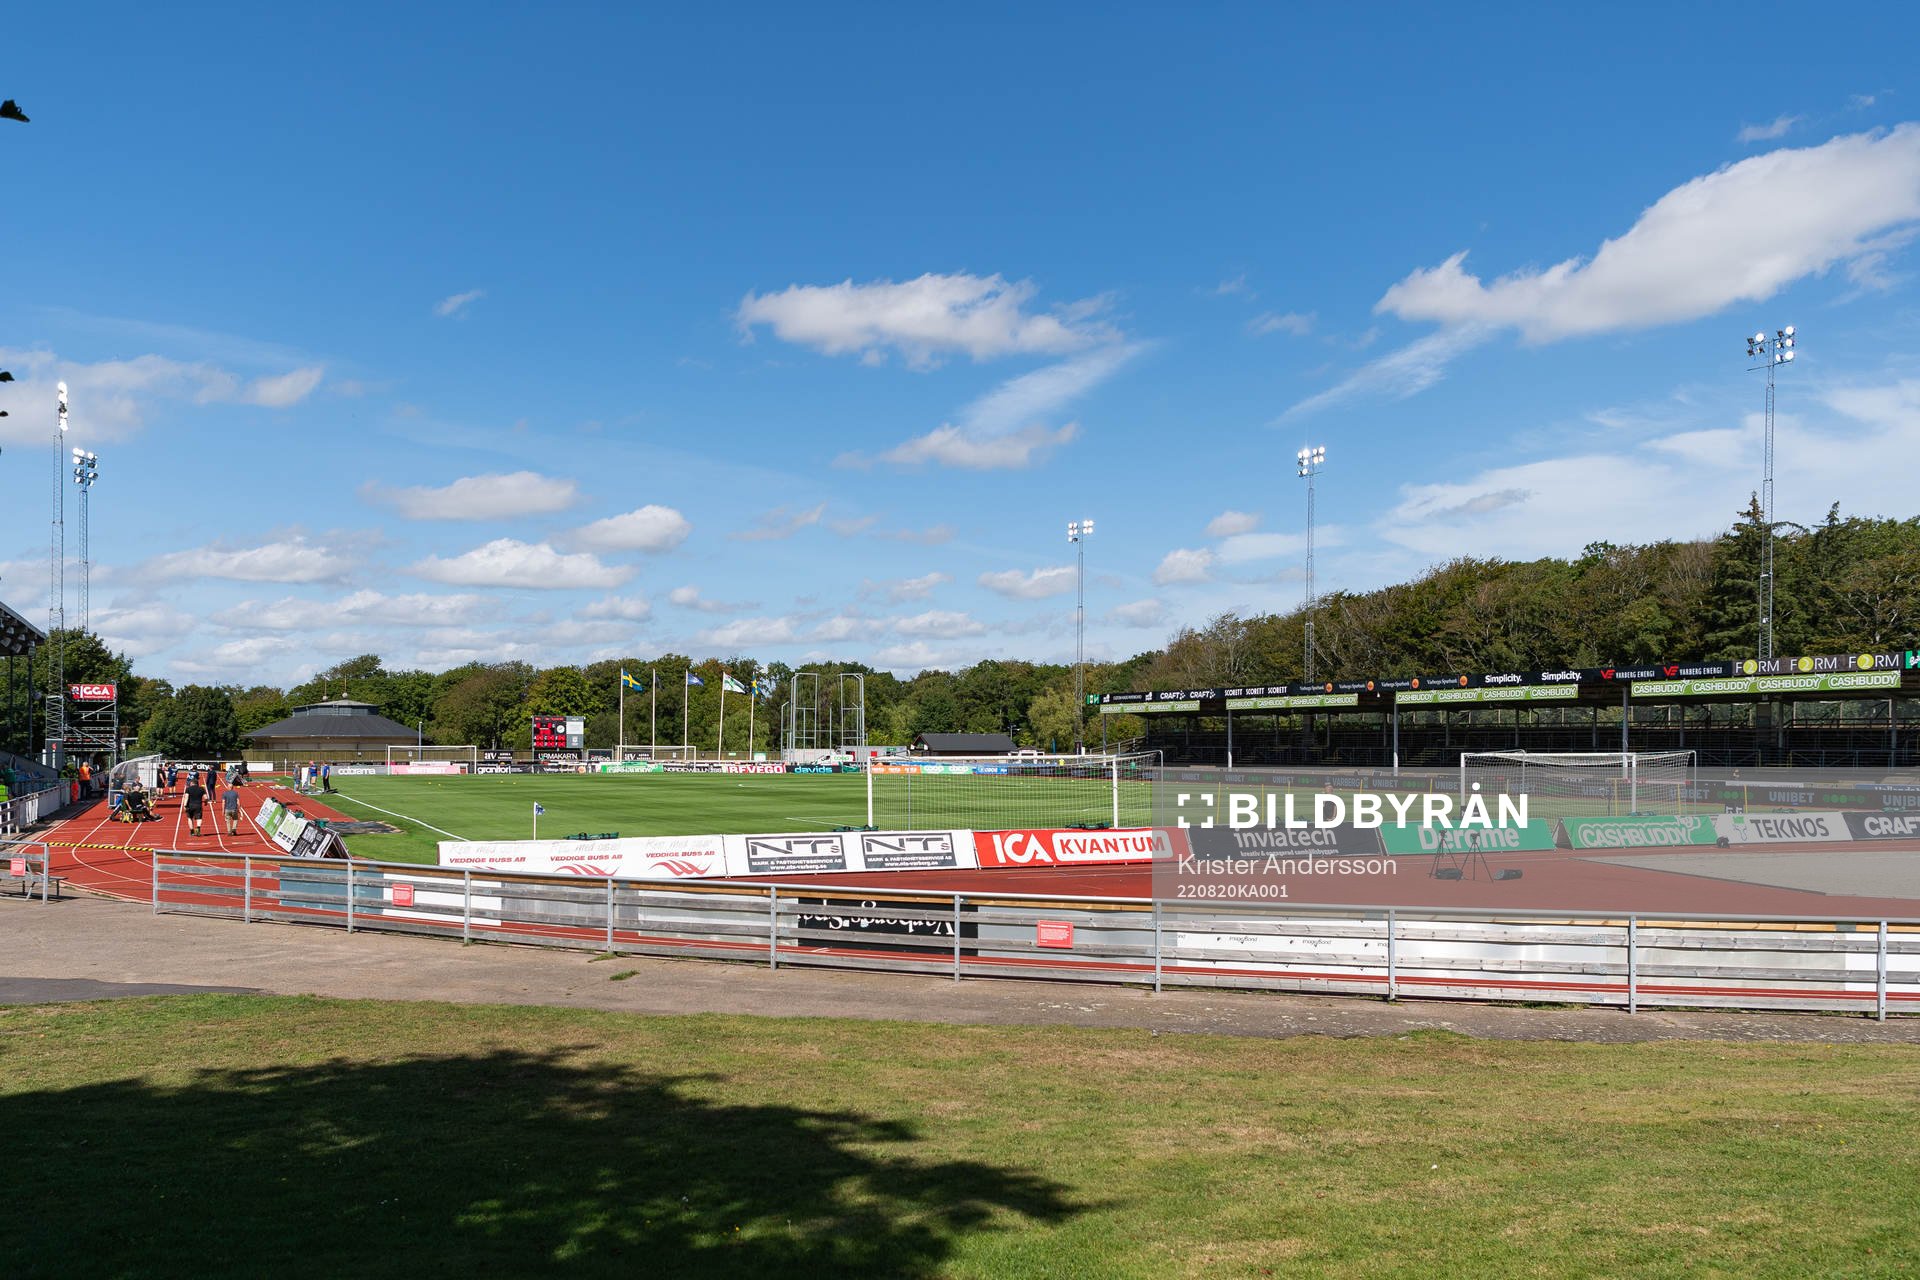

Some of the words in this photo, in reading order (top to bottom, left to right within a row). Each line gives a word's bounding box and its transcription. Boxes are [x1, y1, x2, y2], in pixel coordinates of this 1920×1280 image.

[1694, 681, 1750, 691] CASHBUDDY
[1759, 677, 1820, 689] CASHBUDDY
[1830, 675, 1896, 687] CASHBUDDY
[1484, 690, 1525, 698] CASHBUDDY
[1532, 687, 1576, 697] CASHBUDDY
[1634, 684, 1685, 694] CASHBUDDY
[1160, 692, 1180, 700] CRAFT
[1190, 690, 1210, 699] CRAFT
[1440, 692, 1478, 700] CASHBUDDY
[794, 765, 833, 774] davids
[1372, 779, 1398, 788] UNIBET
[1769, 791, 1814, 802] UNIBET
[1750, 817, 1829, 839] TEKNOS
[1233, 828, 1337, 848] inviatech
[1418, 825, 1520, 850] Derome
[1583, 825, 1689, 847] CASHBUDDY
[992, 833, 1053, 864] ICA
[1059, 836, 1167, 855] KVANTUM
[550, 854, 585, 862] VEDDIGE
